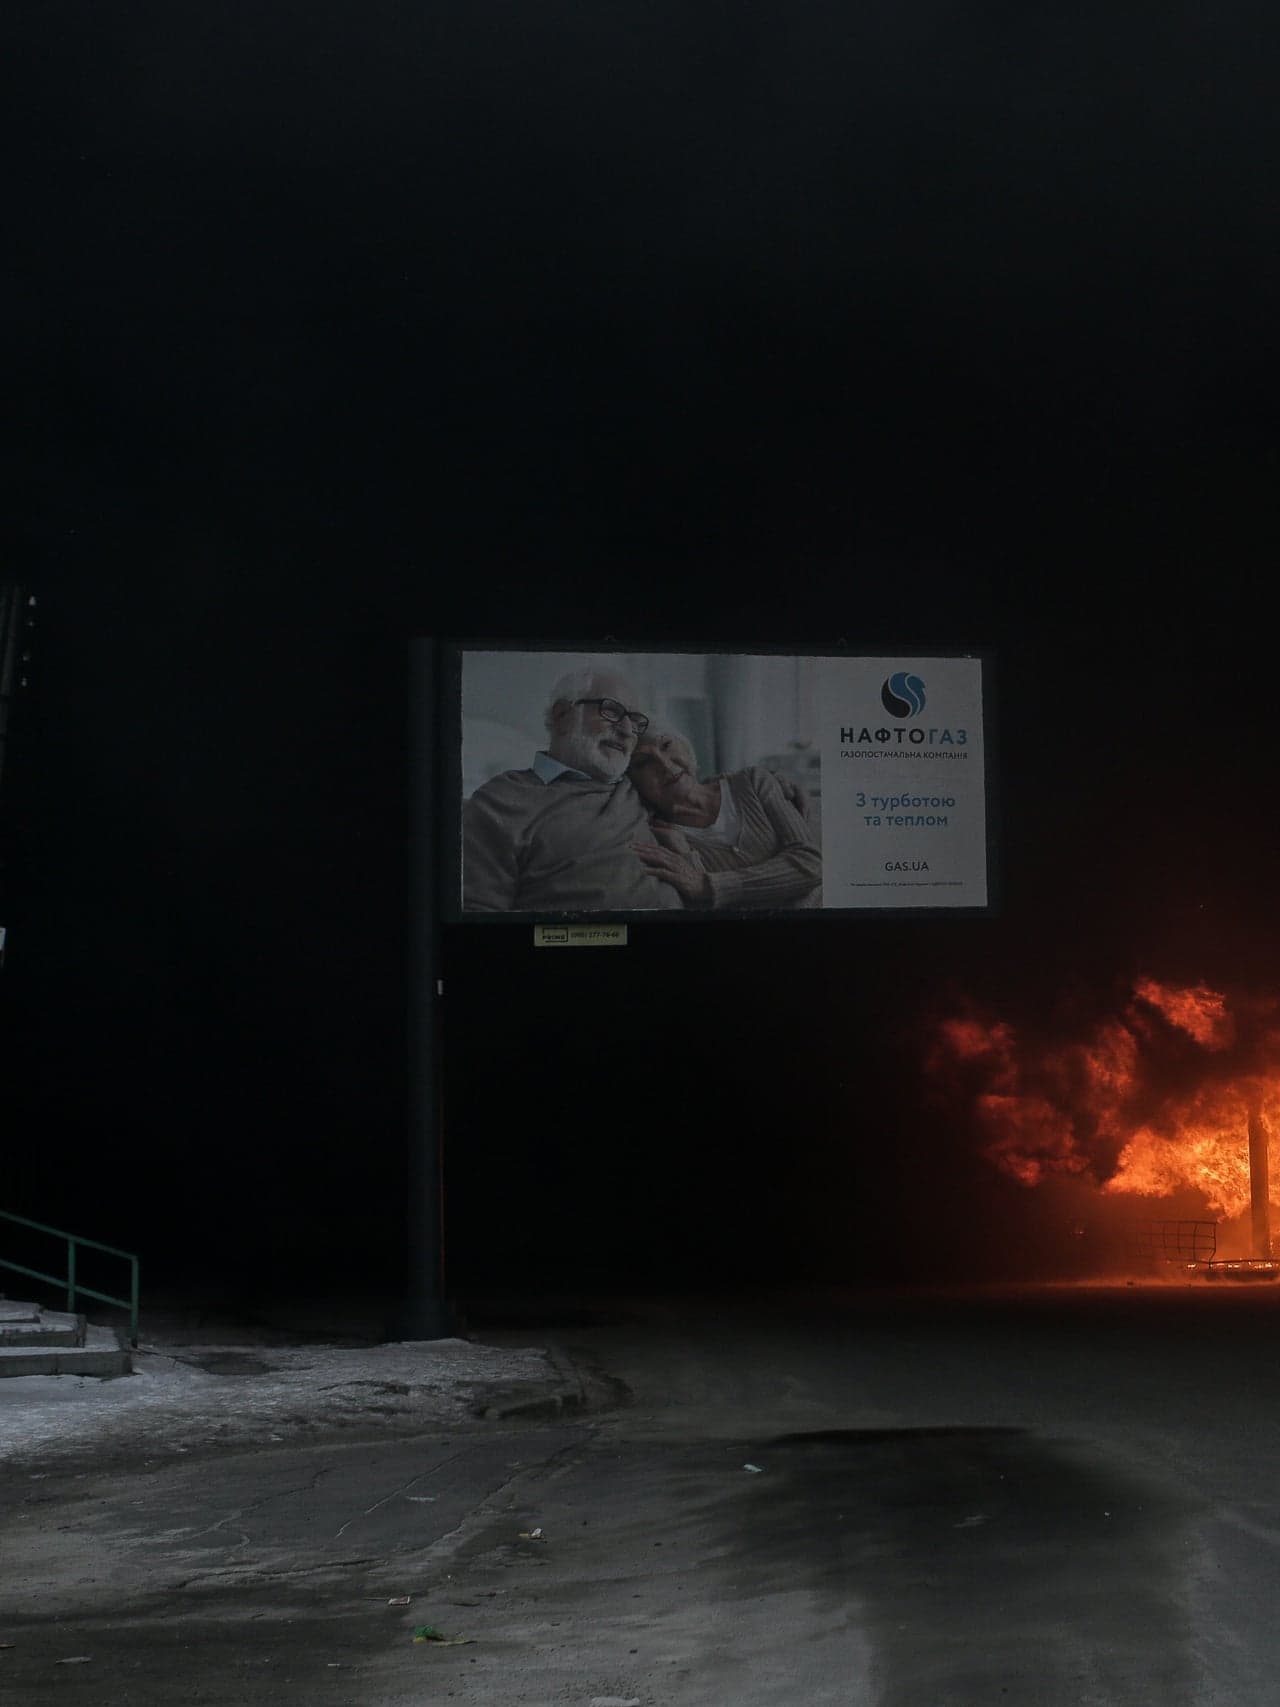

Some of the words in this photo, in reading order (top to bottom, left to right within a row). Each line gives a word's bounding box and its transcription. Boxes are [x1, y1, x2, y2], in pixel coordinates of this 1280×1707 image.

[840, 727, 968, 745] НАФТОГАЗ
[840, 750, 922, 759] ГАЗОПОСТАЧАЛЬНА
[923, 751, 968, 760] КОМПАНІЯ
[871, 793, 956, 811] турботою
[863, 815, 881, 827] та
[886, 815, 948, 827] теплом
[884, 861, 930, 872] GAS.UA
